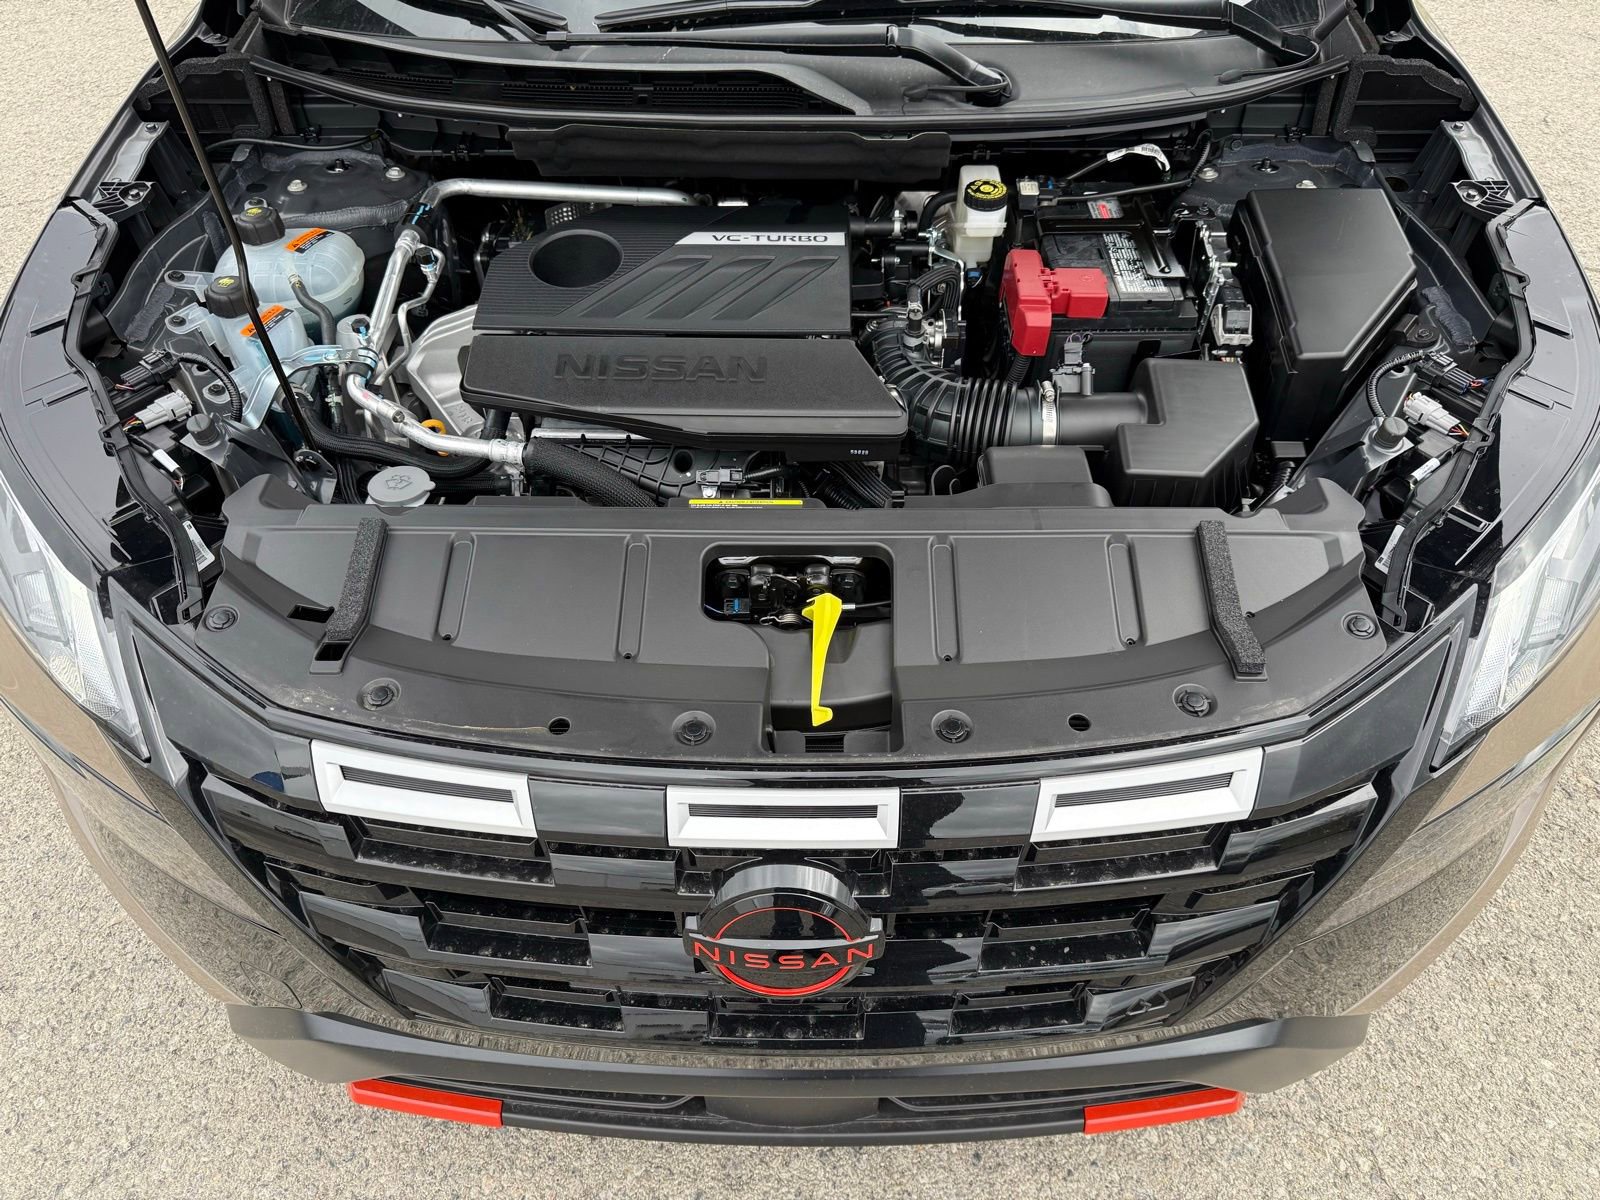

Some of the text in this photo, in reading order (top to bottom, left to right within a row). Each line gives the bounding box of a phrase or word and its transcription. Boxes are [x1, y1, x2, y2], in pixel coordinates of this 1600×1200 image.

[711, 234, 828, 243] VC-TURBO
[553, 353, 768, 382] NISSAN
[694, 941, 874, 970] NISSAN
